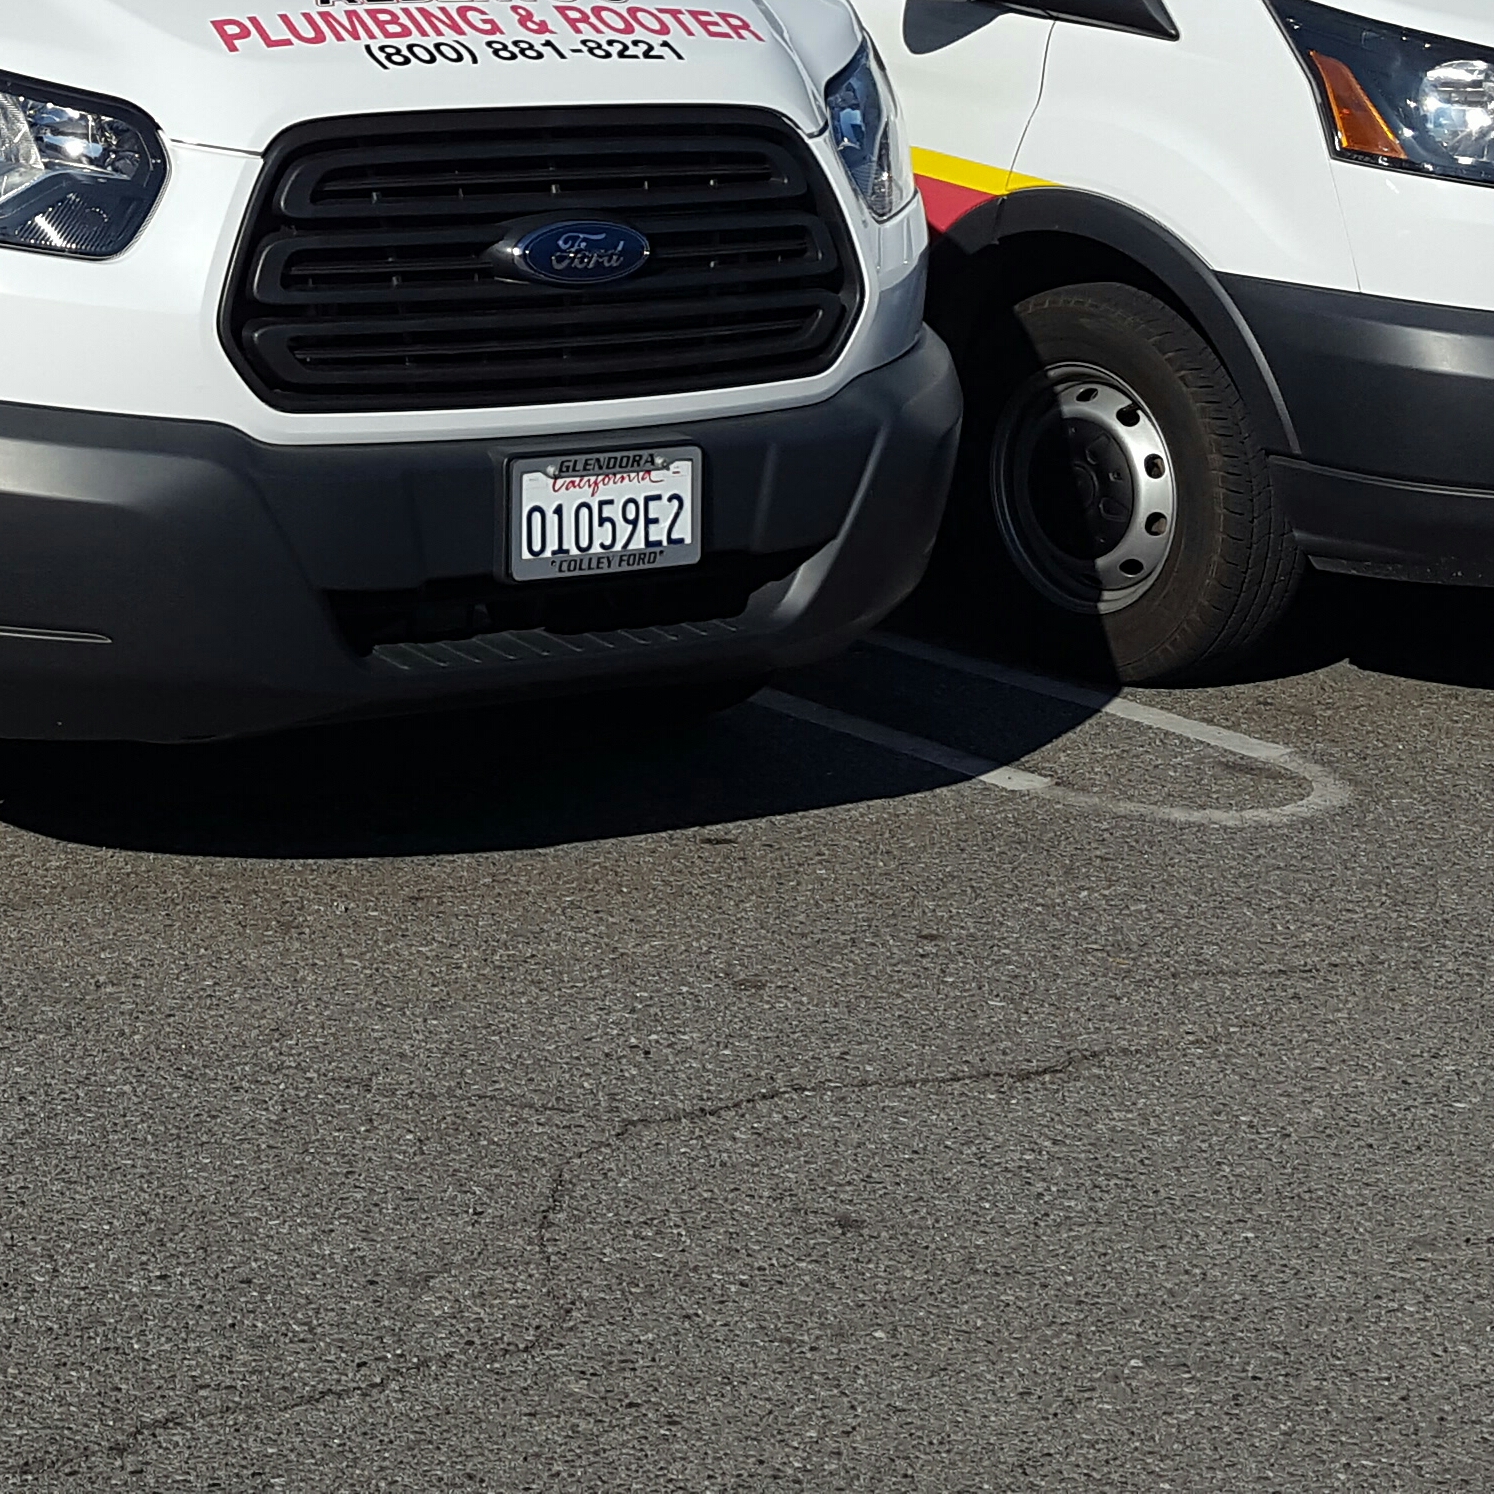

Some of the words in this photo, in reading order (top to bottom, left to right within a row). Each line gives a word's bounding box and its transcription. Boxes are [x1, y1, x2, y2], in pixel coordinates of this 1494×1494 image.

[210, 5, 506, 53] PLUMBING
[509, 4, 558, 36] &
[552, 5, 766, 43] ROOTER
[364, 40, 479, 70] (800)
[485, 39, 686, 61] 881-8221
[552, 232, 625, 270] Ford
[558, 453, 657, 474] GLENDORA
[526, 493, 686, 557] 01059E2
